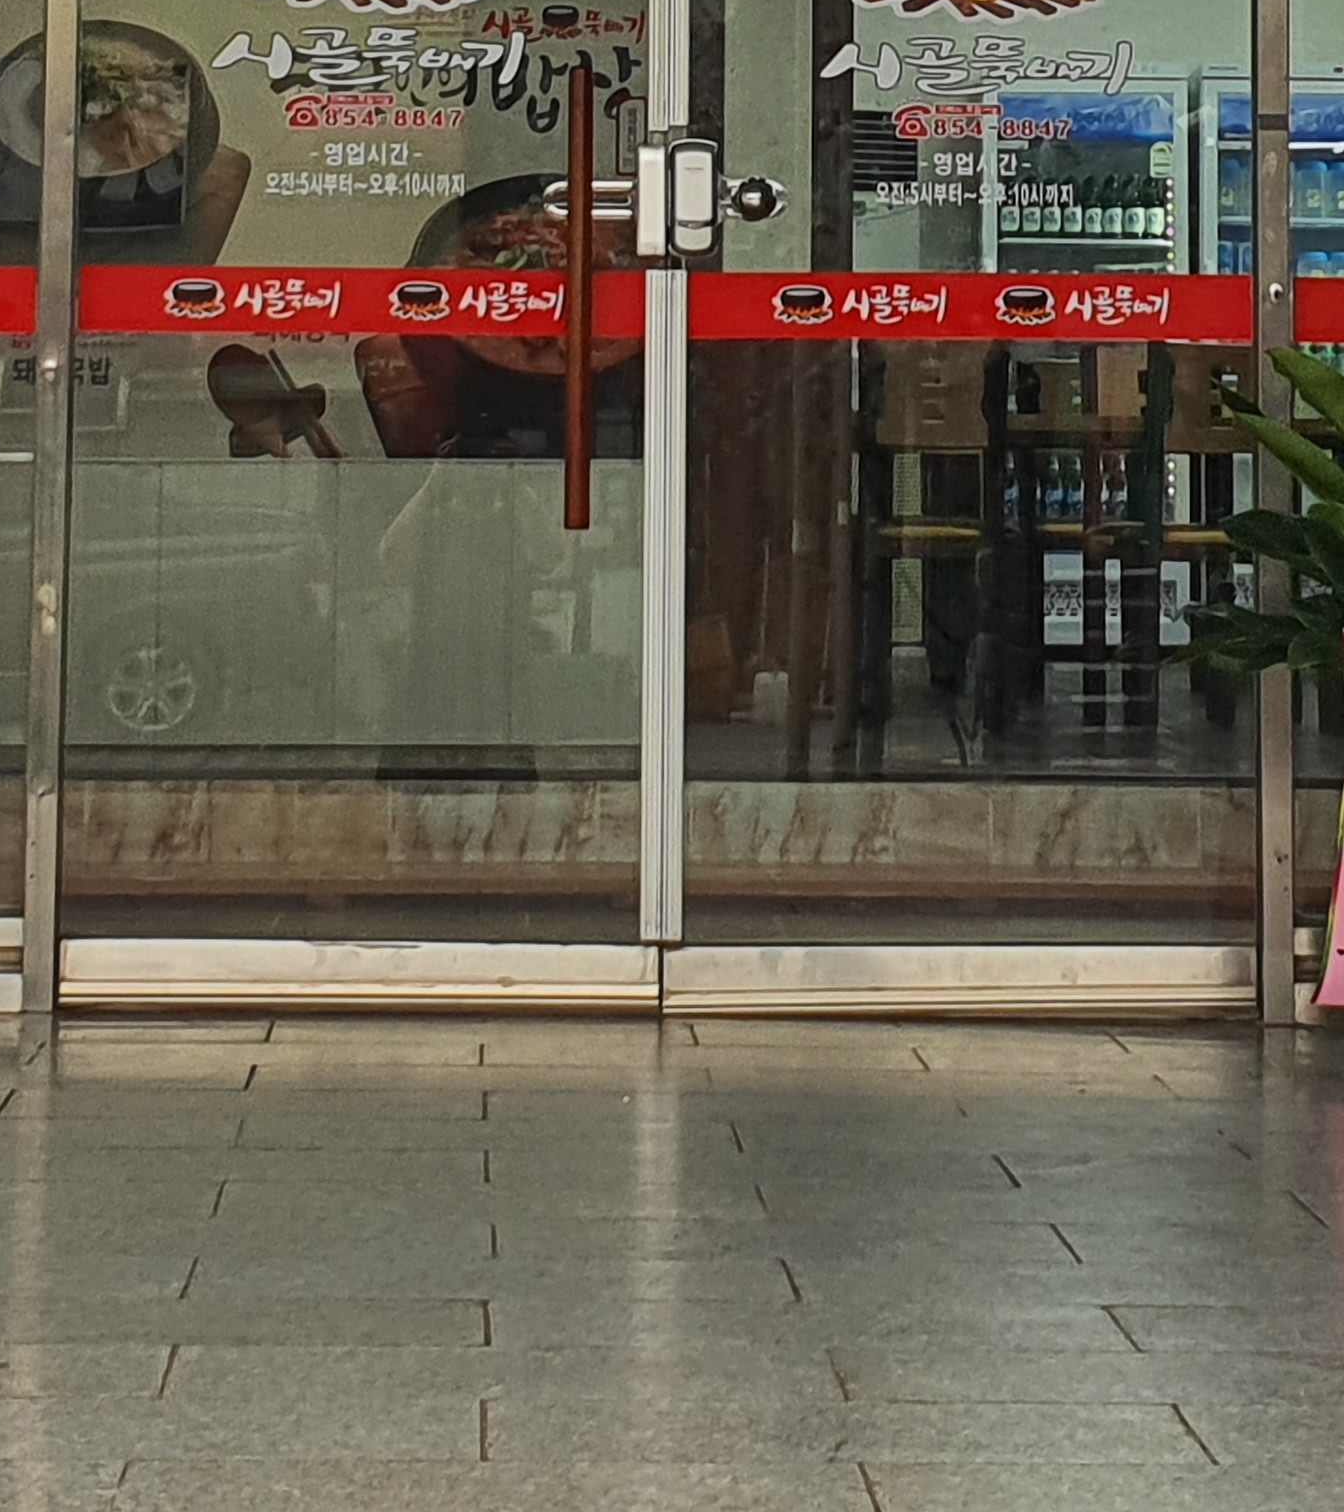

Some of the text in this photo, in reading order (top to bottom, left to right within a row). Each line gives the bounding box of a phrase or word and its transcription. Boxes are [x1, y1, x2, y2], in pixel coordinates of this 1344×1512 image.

[212, 25, 528, 86] 시골뚝배기
[821, 36, 1135, 95] 시골뚝배기
[932, 117, 1074, 138] 854-8847
